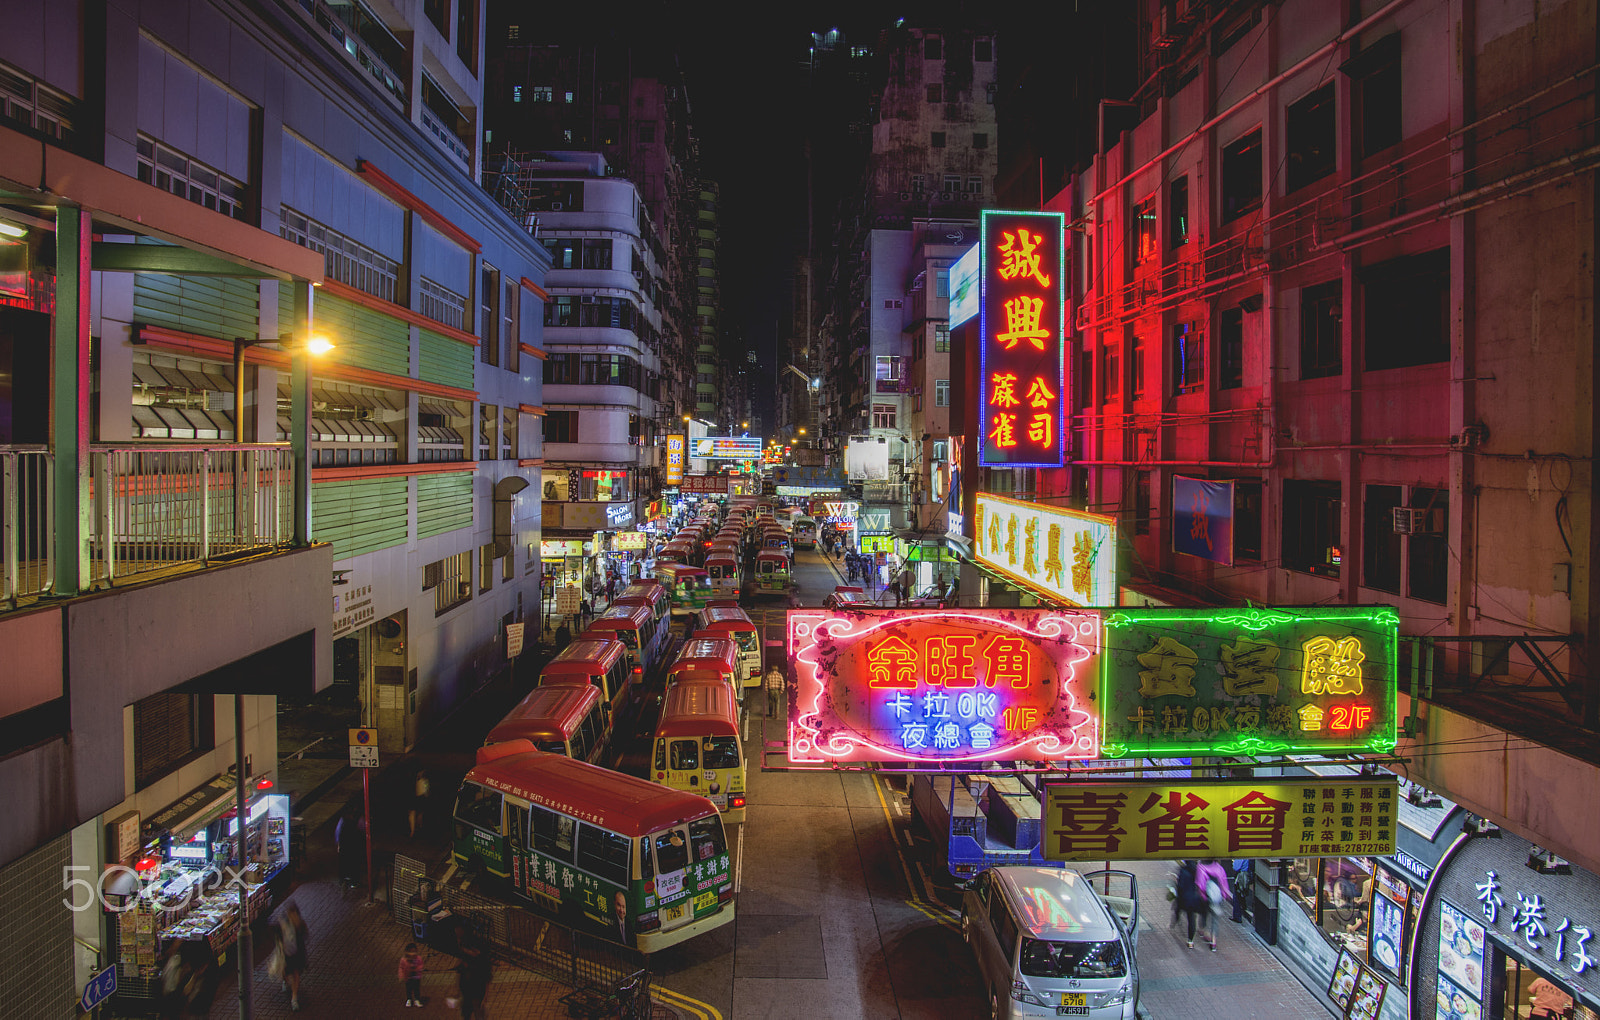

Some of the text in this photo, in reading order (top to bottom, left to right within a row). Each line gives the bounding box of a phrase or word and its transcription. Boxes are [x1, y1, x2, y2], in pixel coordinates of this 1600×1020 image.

[997, 229, 1050, 351] 誠興
[1026, 376, 1055, 449] 公司
[606, 505, 628, 519] SALON
[614, 512, 632, 525] MORE
[823, 502, 859, 518] WP
[867, 635, 1031, 689] 金旺角
[886, 691, 997, 718] 卡拉OK
[1002, 707, 1038, 731] 1/F
[1329, 706, 1372, 730] 2/F
[901, 721, 995, 749] 夜總會
[368, 759, 378, 767] 12
[485, 777, 498, 787] PUBLIC
[500, 782, 512, 792] LIGHT
[513, 786, 521, 795] BUS
[530, 792, 544, 803] SEATS
[1052, 790, 1293, 854] 喜雀會
[1475, 871, 1598, 973] 香港仔
